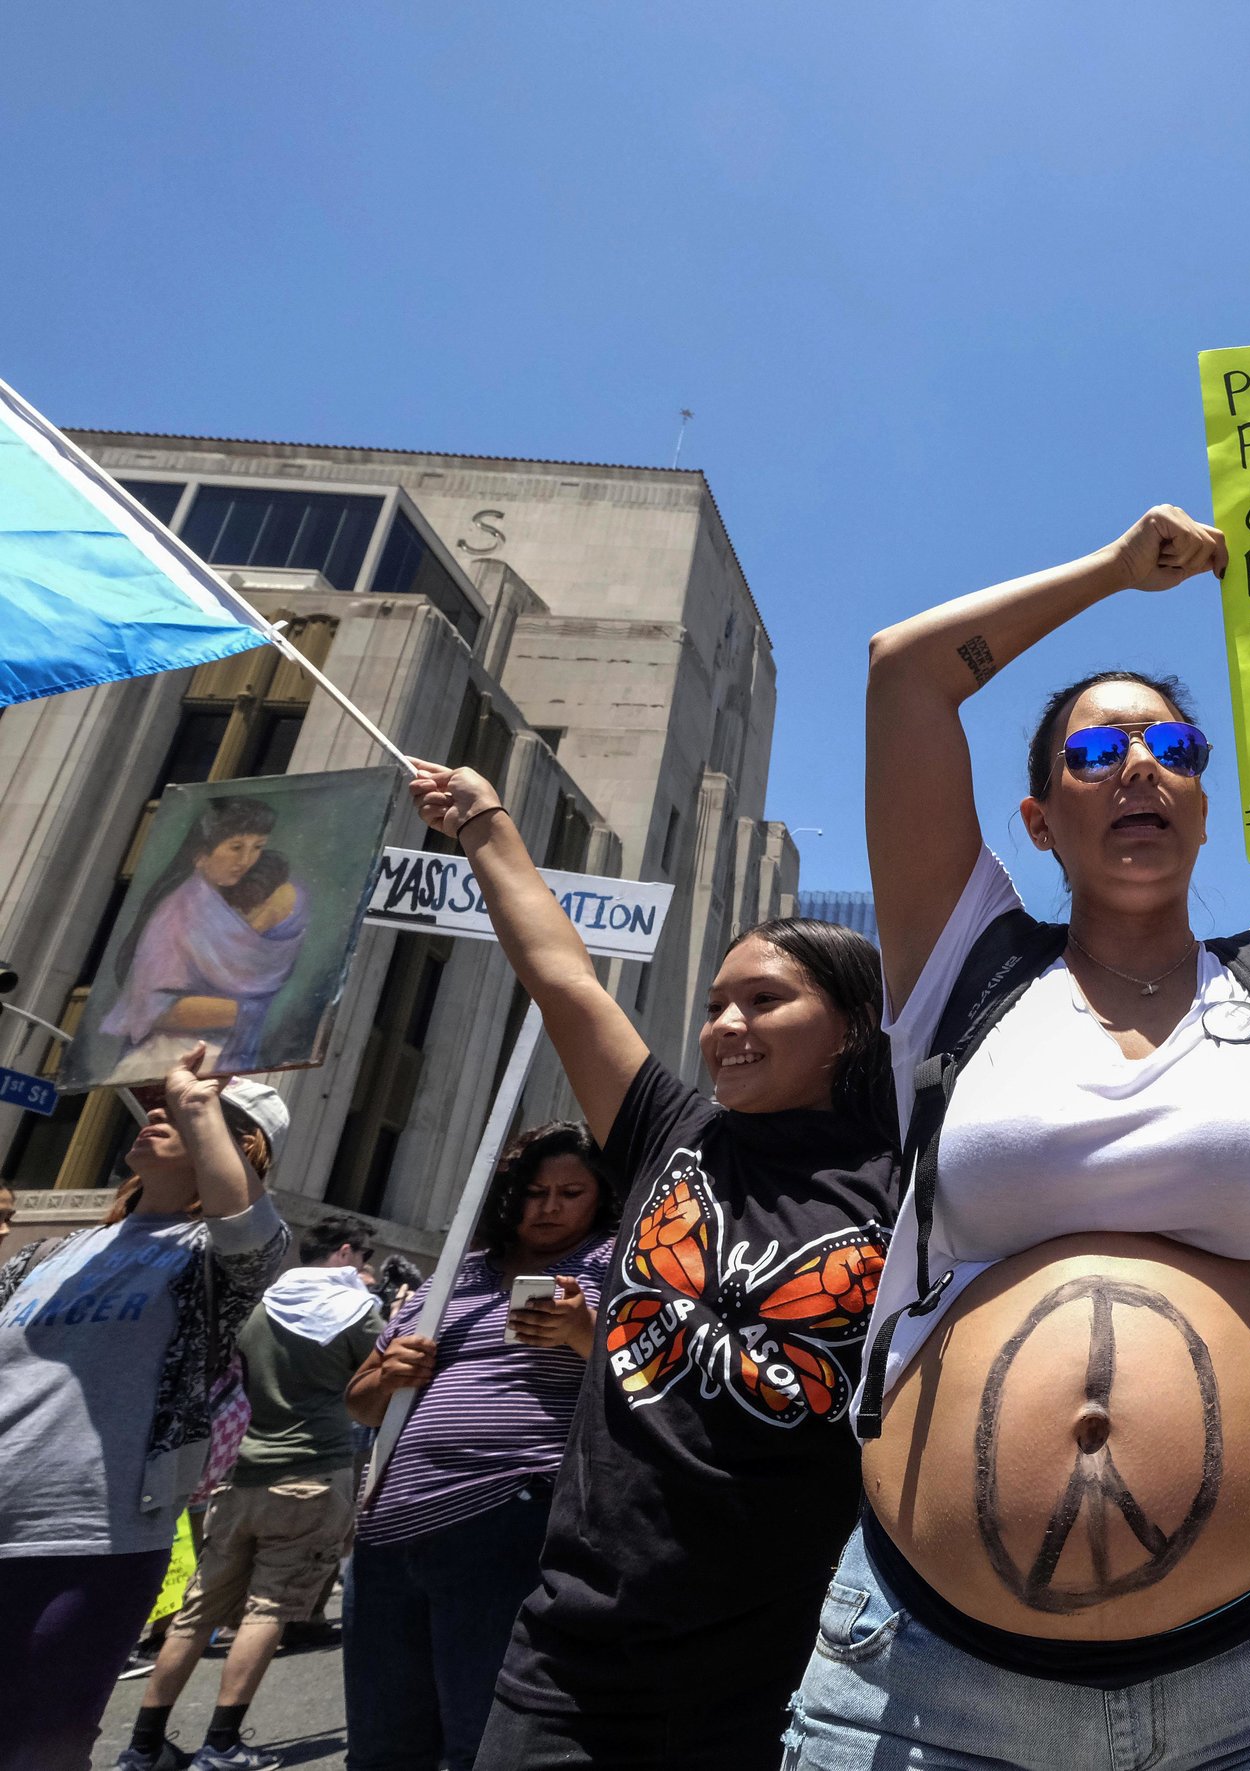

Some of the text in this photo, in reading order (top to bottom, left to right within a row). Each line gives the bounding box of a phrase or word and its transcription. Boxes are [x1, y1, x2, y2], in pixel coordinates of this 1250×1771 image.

[967, 955, 1023, 1020] DAKINE
[0, 1075, 49, 1106] 1st St
[610, 1321, 667, 1377] RISE
[661, 1298, 696, 1333] UP
[739, 1323, 779, 1364] AS
